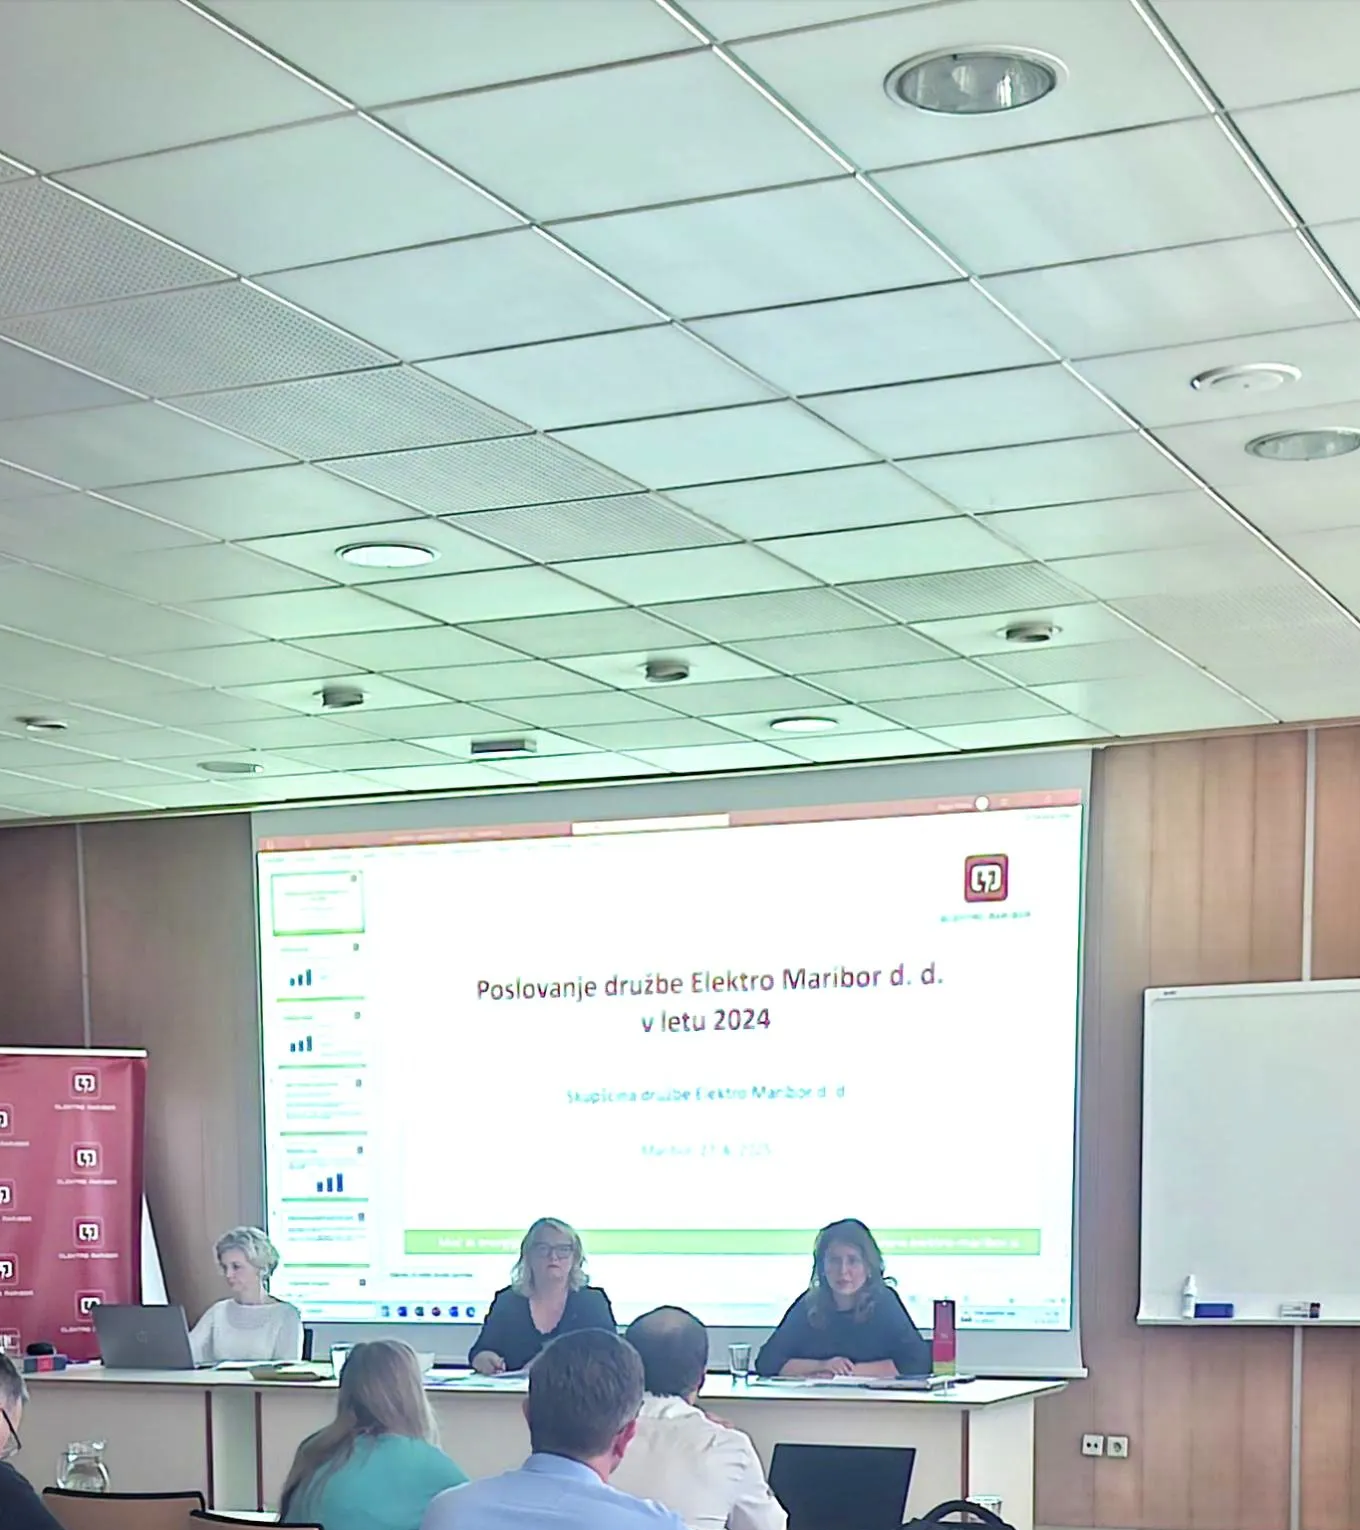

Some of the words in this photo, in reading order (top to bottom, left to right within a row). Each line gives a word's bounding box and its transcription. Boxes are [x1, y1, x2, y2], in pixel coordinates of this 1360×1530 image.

[477, 976, 597, 1002] Poslovanje
[604, 974, 683, 996] družbe
[691, 970, 775, 993] Elektro
[782, 965, 882, 990] Maribor
[890, 963, 912, 987] d.
[921, 961, 943, 985] d.
[641, 1016, 654, 1033] v
[661, 1010, 706, 1033] letu
[713, 1008, 771, 1031] 2024
